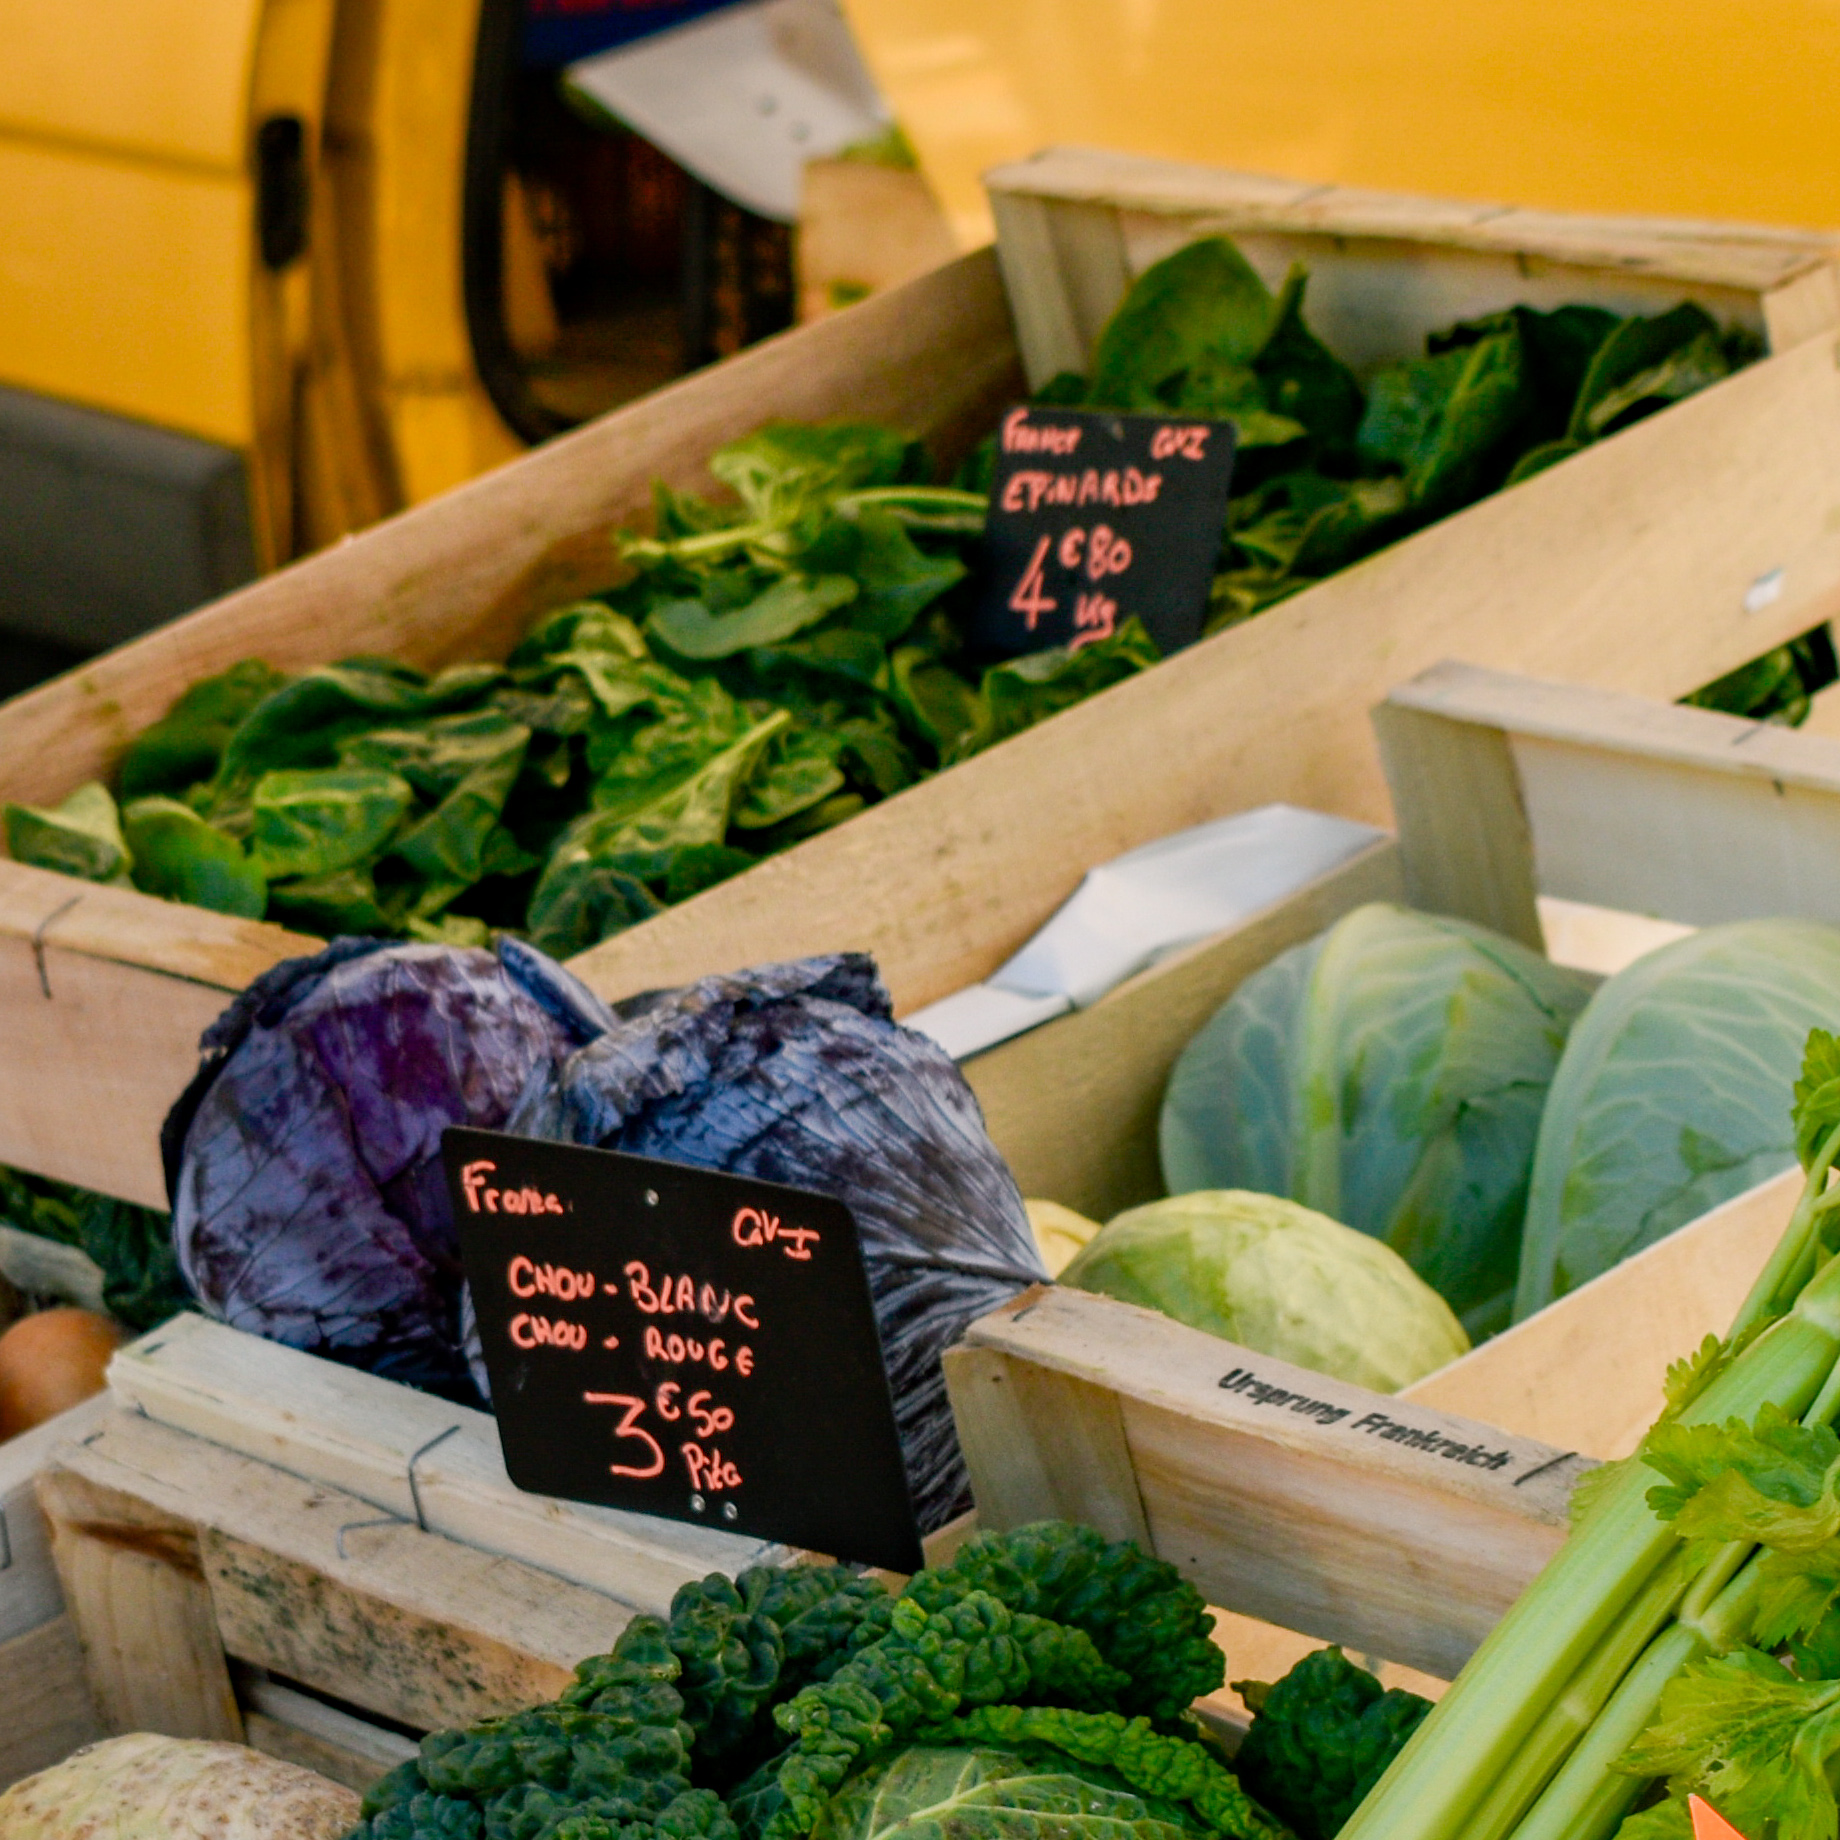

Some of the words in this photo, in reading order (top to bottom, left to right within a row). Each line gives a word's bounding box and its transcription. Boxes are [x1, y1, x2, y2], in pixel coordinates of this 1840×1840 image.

[507, 1255, 596, 1302] CHOU
[623, 1260, 760, 1329] BLANC
[509, 1312, 588, 1350] CHOU
[644, 1325, 755, 1378] ROUGE
[1218, 1368, 1351, 1425] Ursprung
[1351, 1412, 1513, 1471] Frankreich
